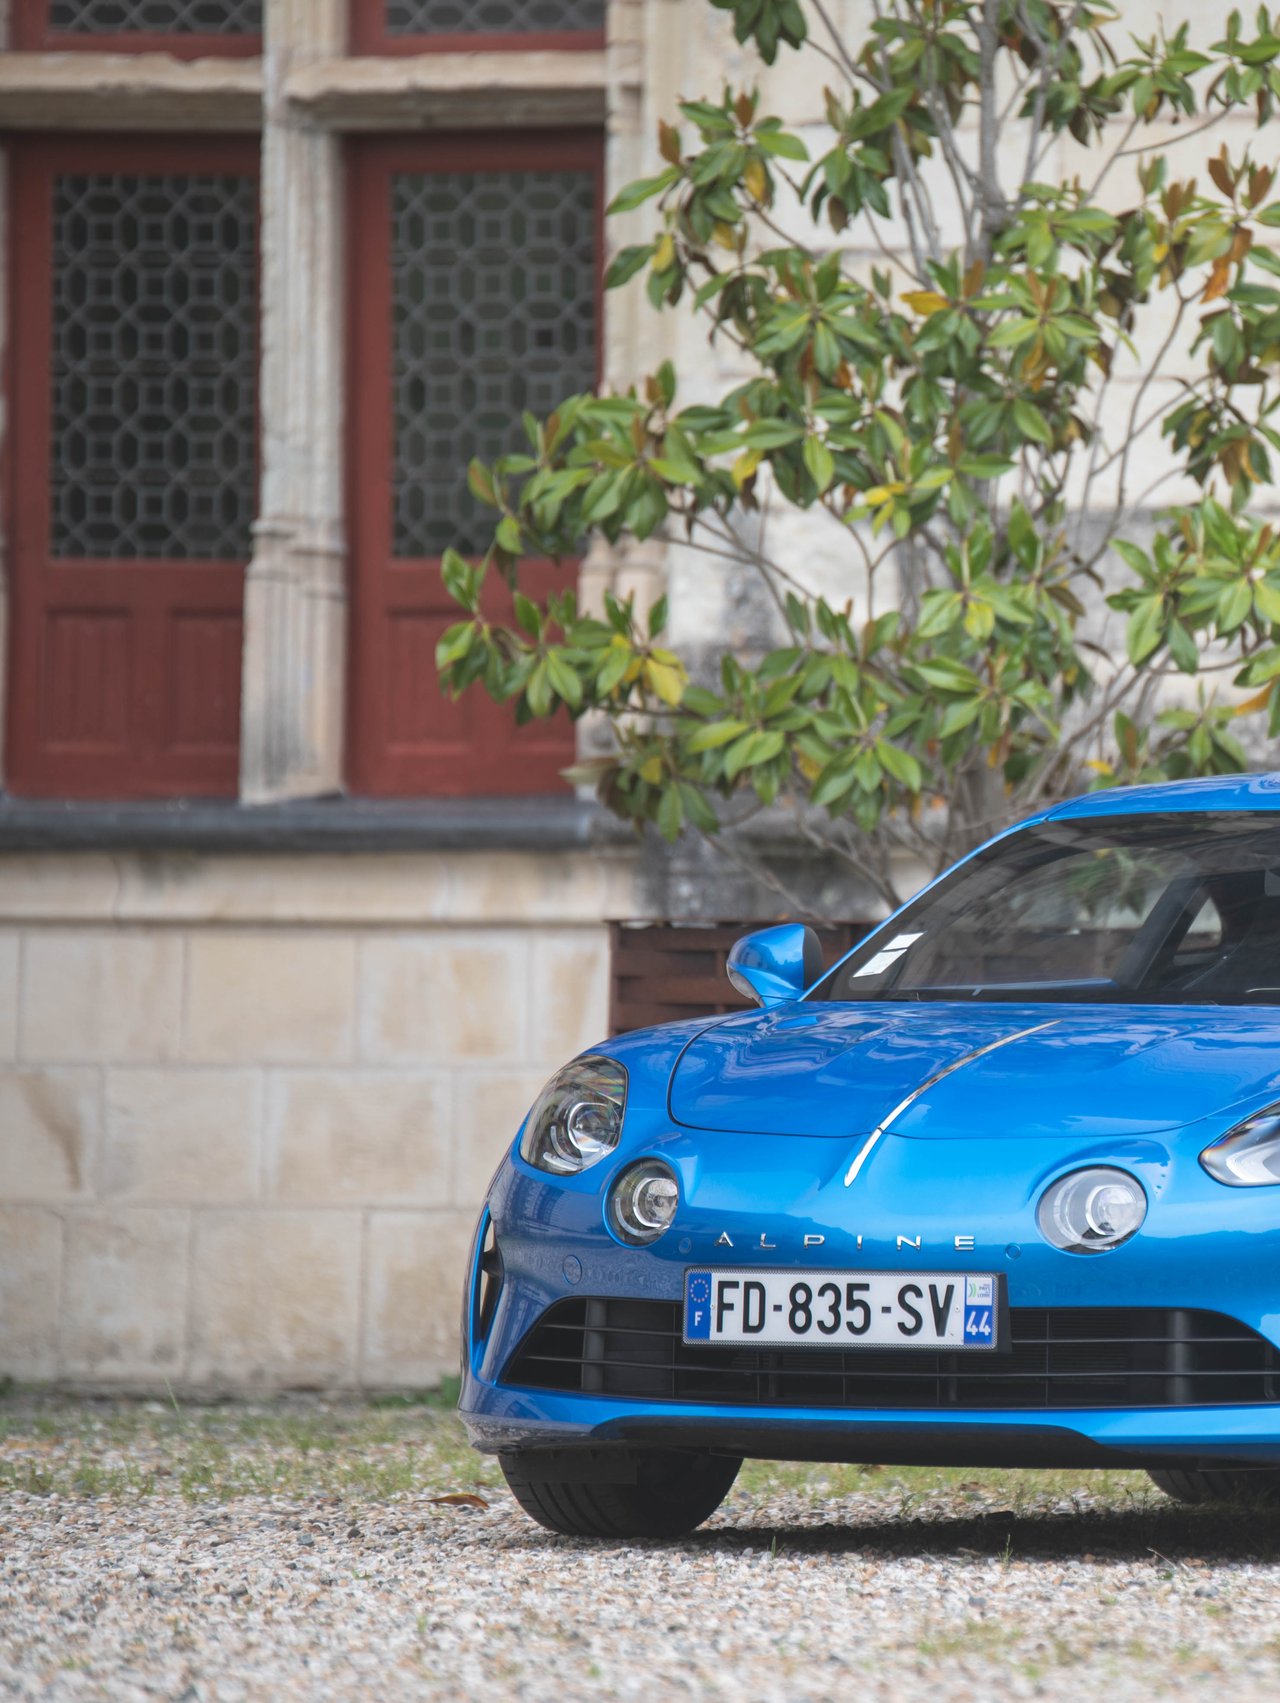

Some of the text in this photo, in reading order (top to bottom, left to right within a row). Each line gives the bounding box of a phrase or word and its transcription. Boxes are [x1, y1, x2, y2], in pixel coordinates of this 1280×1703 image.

[714, 1231, 975, 1253] ALPINE
[694, 1311, 703, 1327] F
[716, 1280, 955, 1337] FD-835-SV
[966, 1310, 991, 1336] 44
